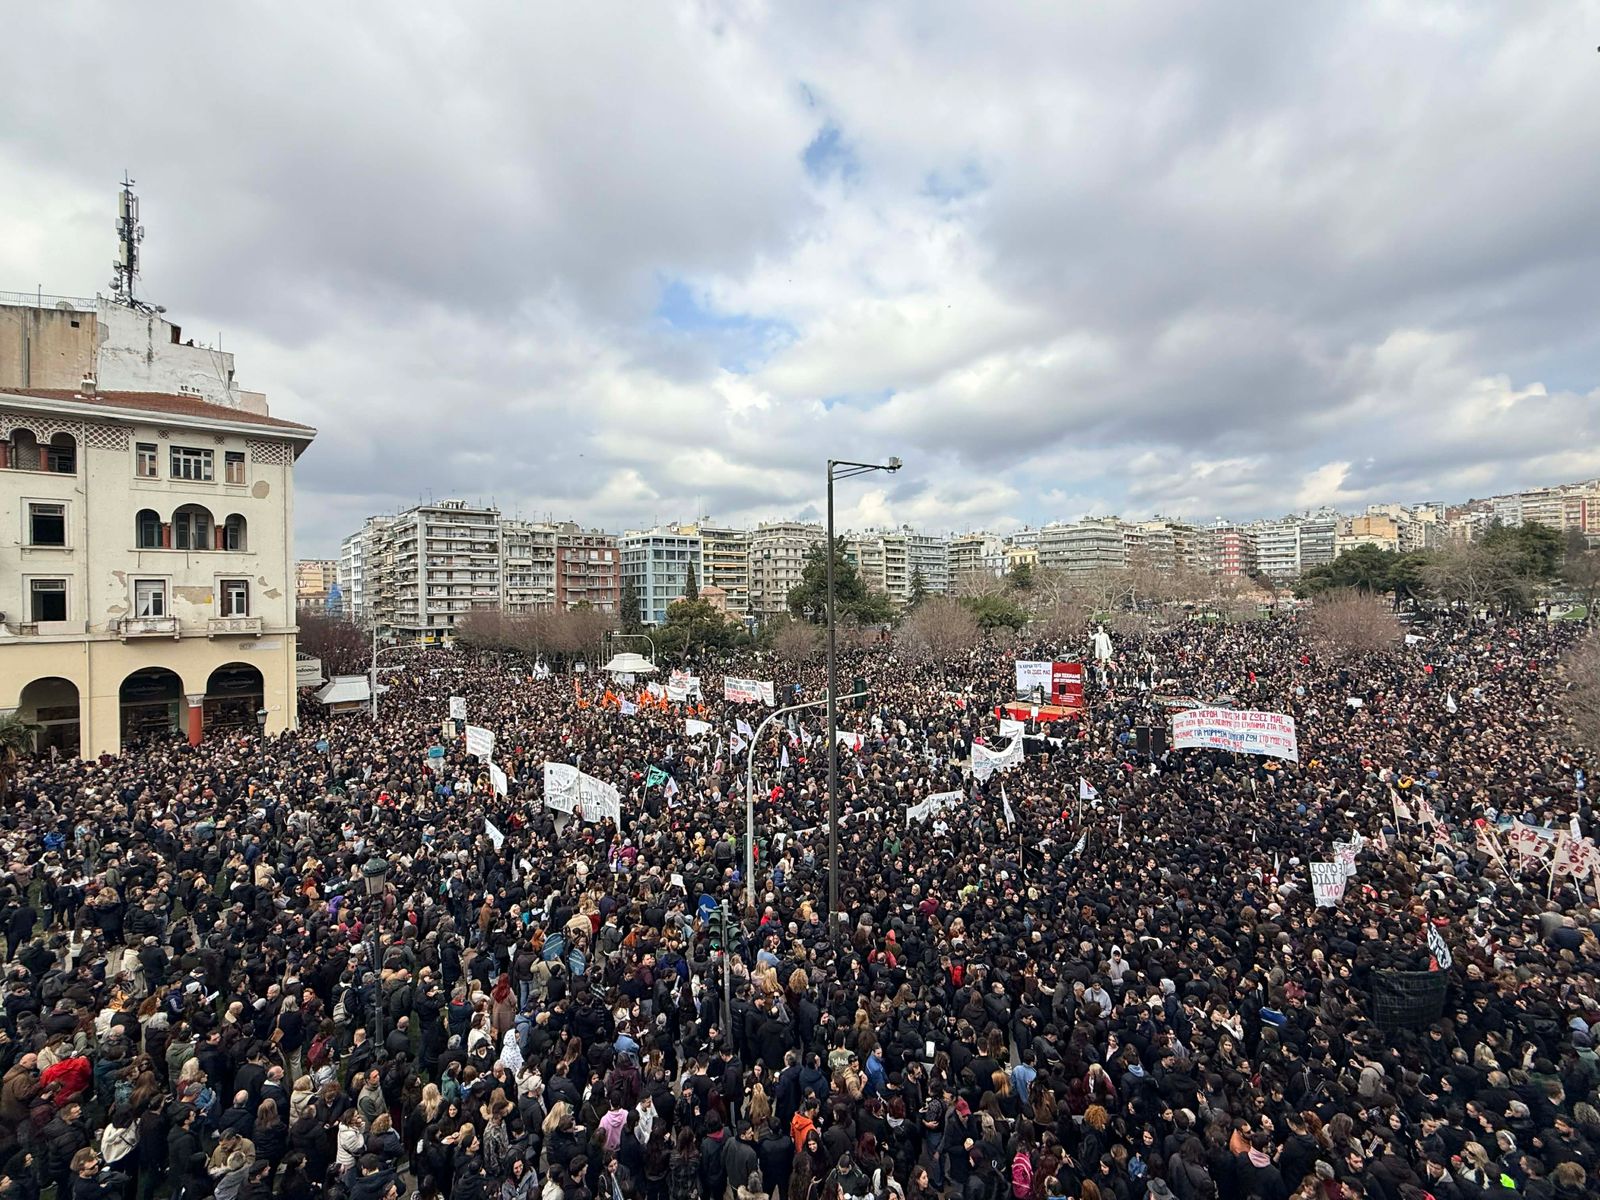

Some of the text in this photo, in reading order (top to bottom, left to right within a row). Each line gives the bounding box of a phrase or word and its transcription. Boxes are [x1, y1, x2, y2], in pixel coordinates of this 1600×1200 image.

[1221, 711, 1232, 719] ΤΟΥΣ
[1250, 713, 1268, 721] ΖΩΕΣ
[1270, 715, 1284, 724] ΜΑΣ
